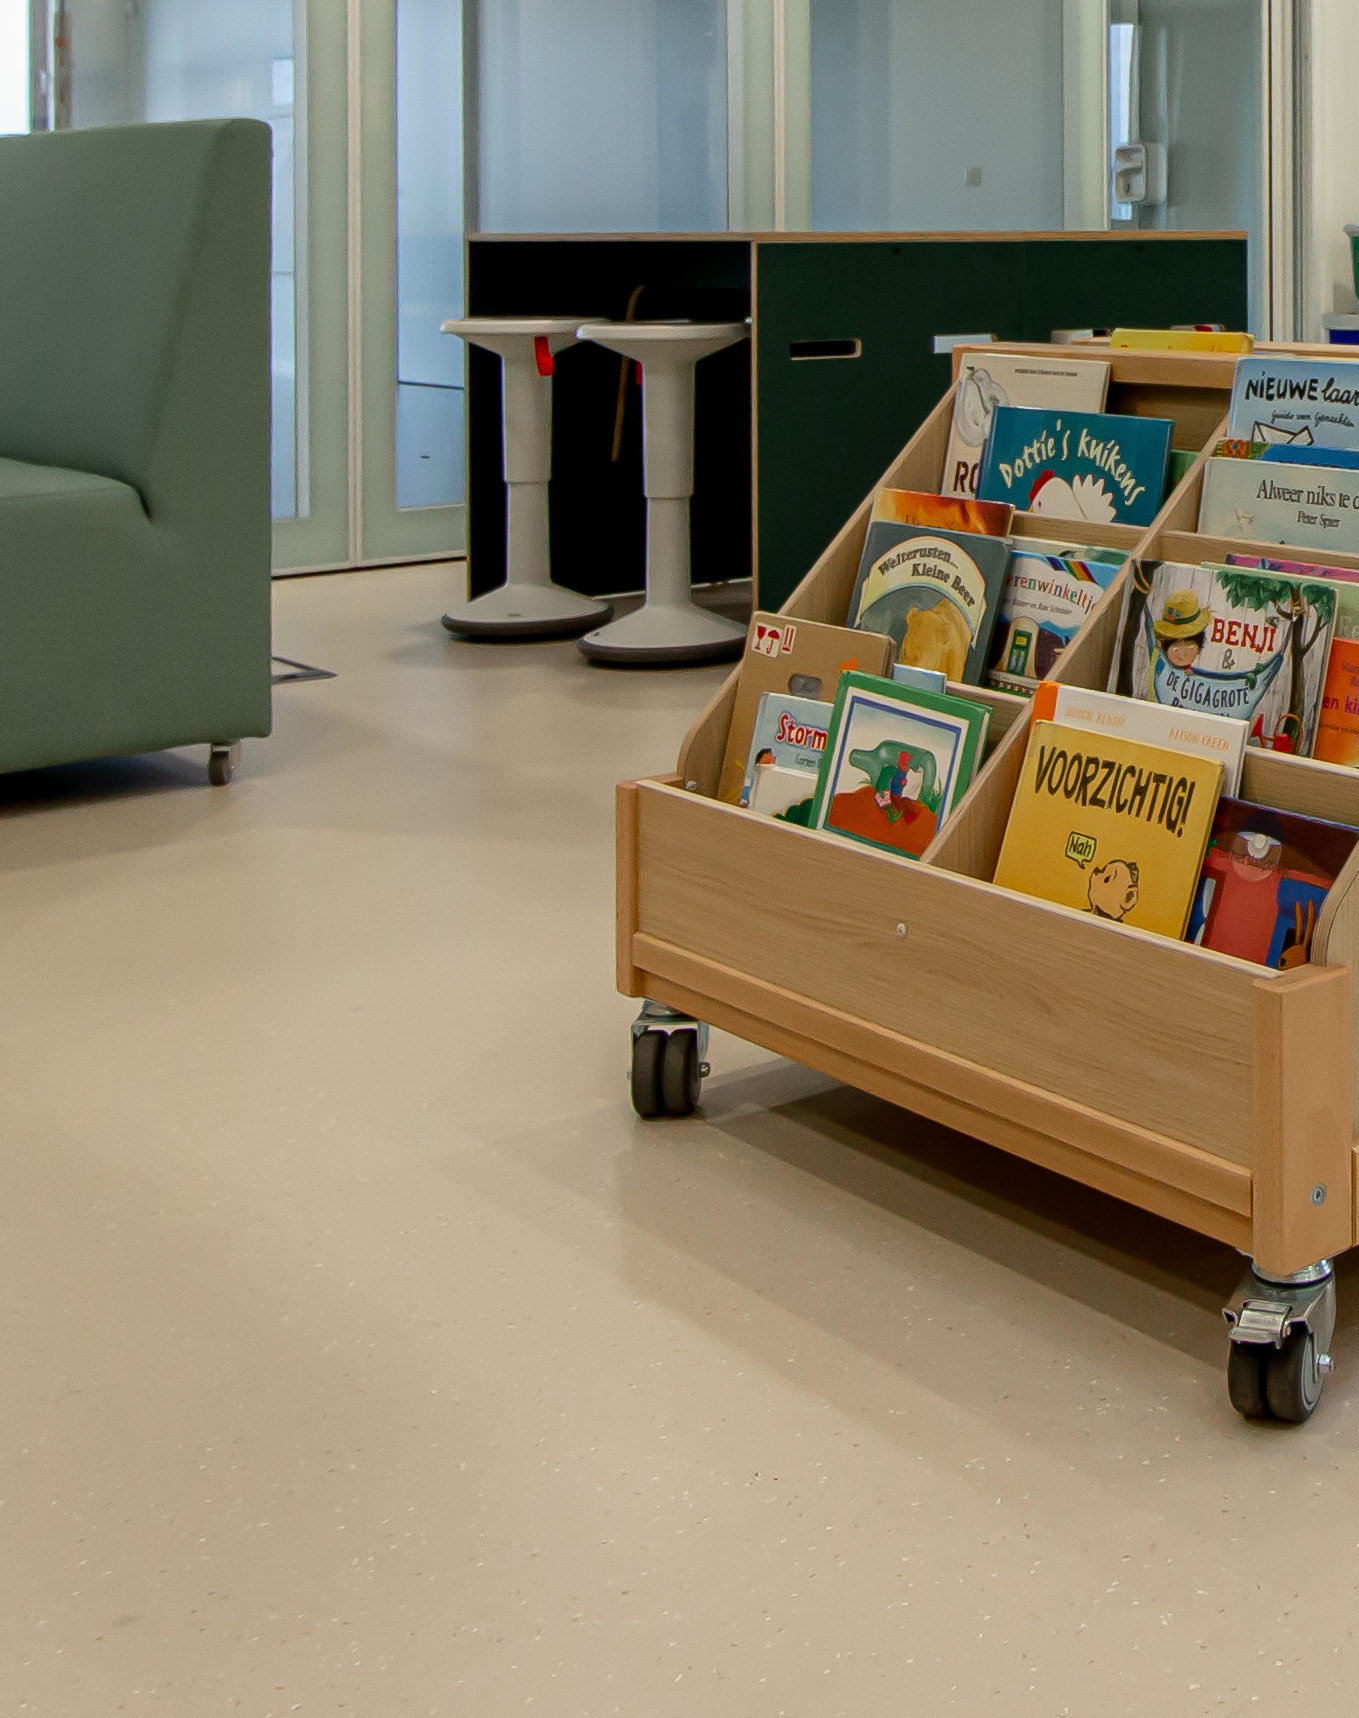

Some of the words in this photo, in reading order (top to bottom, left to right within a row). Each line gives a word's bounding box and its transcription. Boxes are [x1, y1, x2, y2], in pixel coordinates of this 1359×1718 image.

[1256, 479, 1304, 503] Alweer
[1305, 484, 1336, 507] niks
[1337, 492, 1351, 509] te
[911, 562, 951, 583] Kleine
[951, 574, 975, 607] Beer
[1211, 617, 1277, 654] BENJI
[1221, 647, 1236, 670] &
[1166, 670, 1181, 692] DE
[1180, 676, 1250, 709] GIGAGROTE
[775, 712, 828, 751] Storm
[1034, 745, 1196, 839] VOORZICHTIG!
[1069, 836, 1093, 858] Nah
